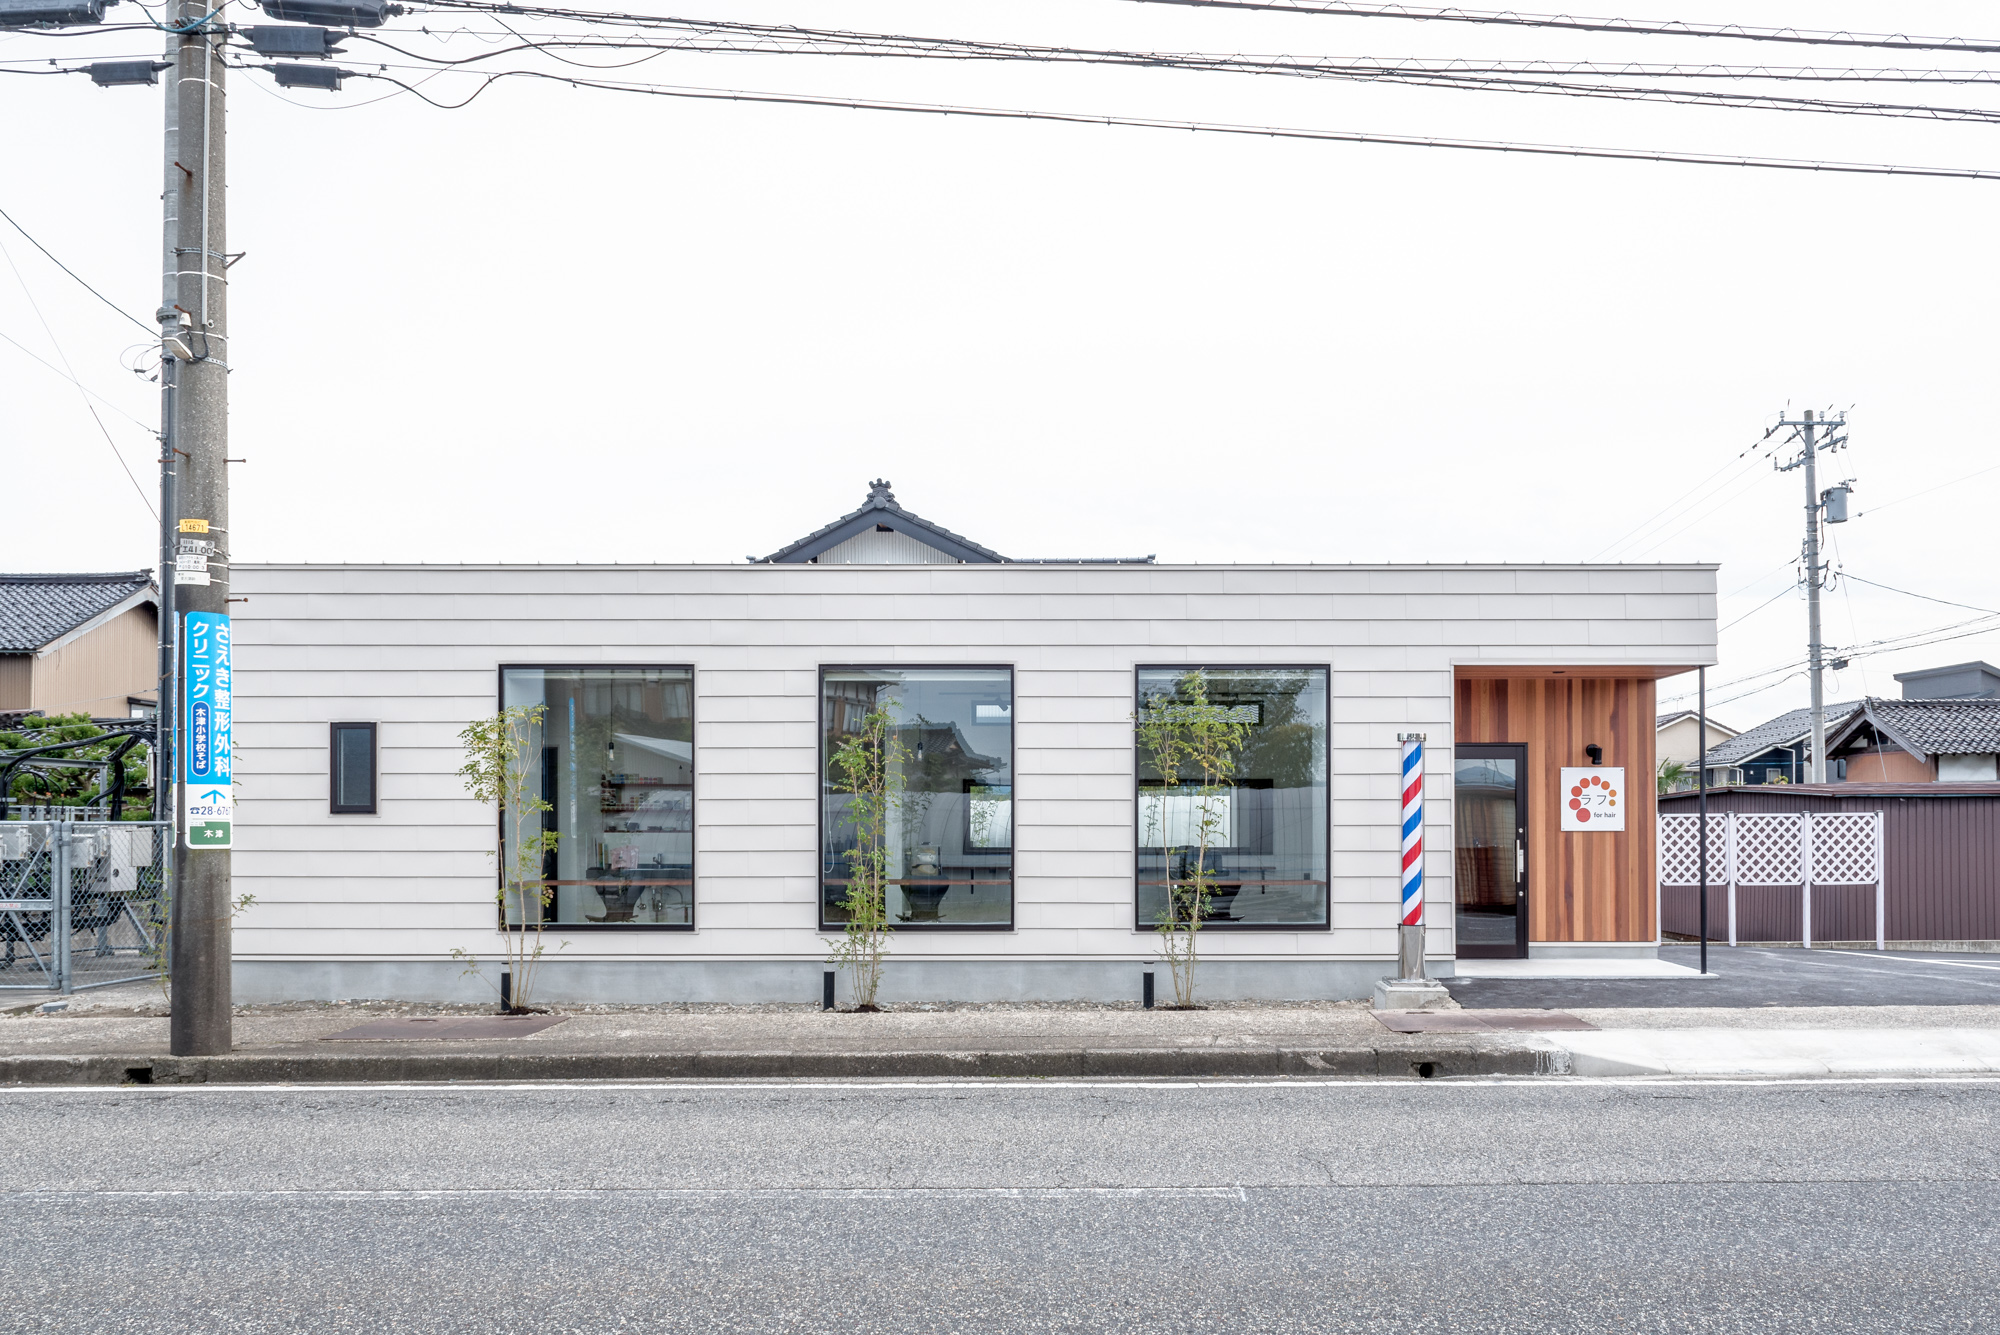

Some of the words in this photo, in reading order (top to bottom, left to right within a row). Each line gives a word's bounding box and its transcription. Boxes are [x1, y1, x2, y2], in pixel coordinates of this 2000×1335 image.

[192, 621, 210, 699] クリニック
[214, 623, 231, 777] さえき整形外科
[195, 708, 207, 769] 木津小学校そば
[204, 829, 224, 838] 木津
